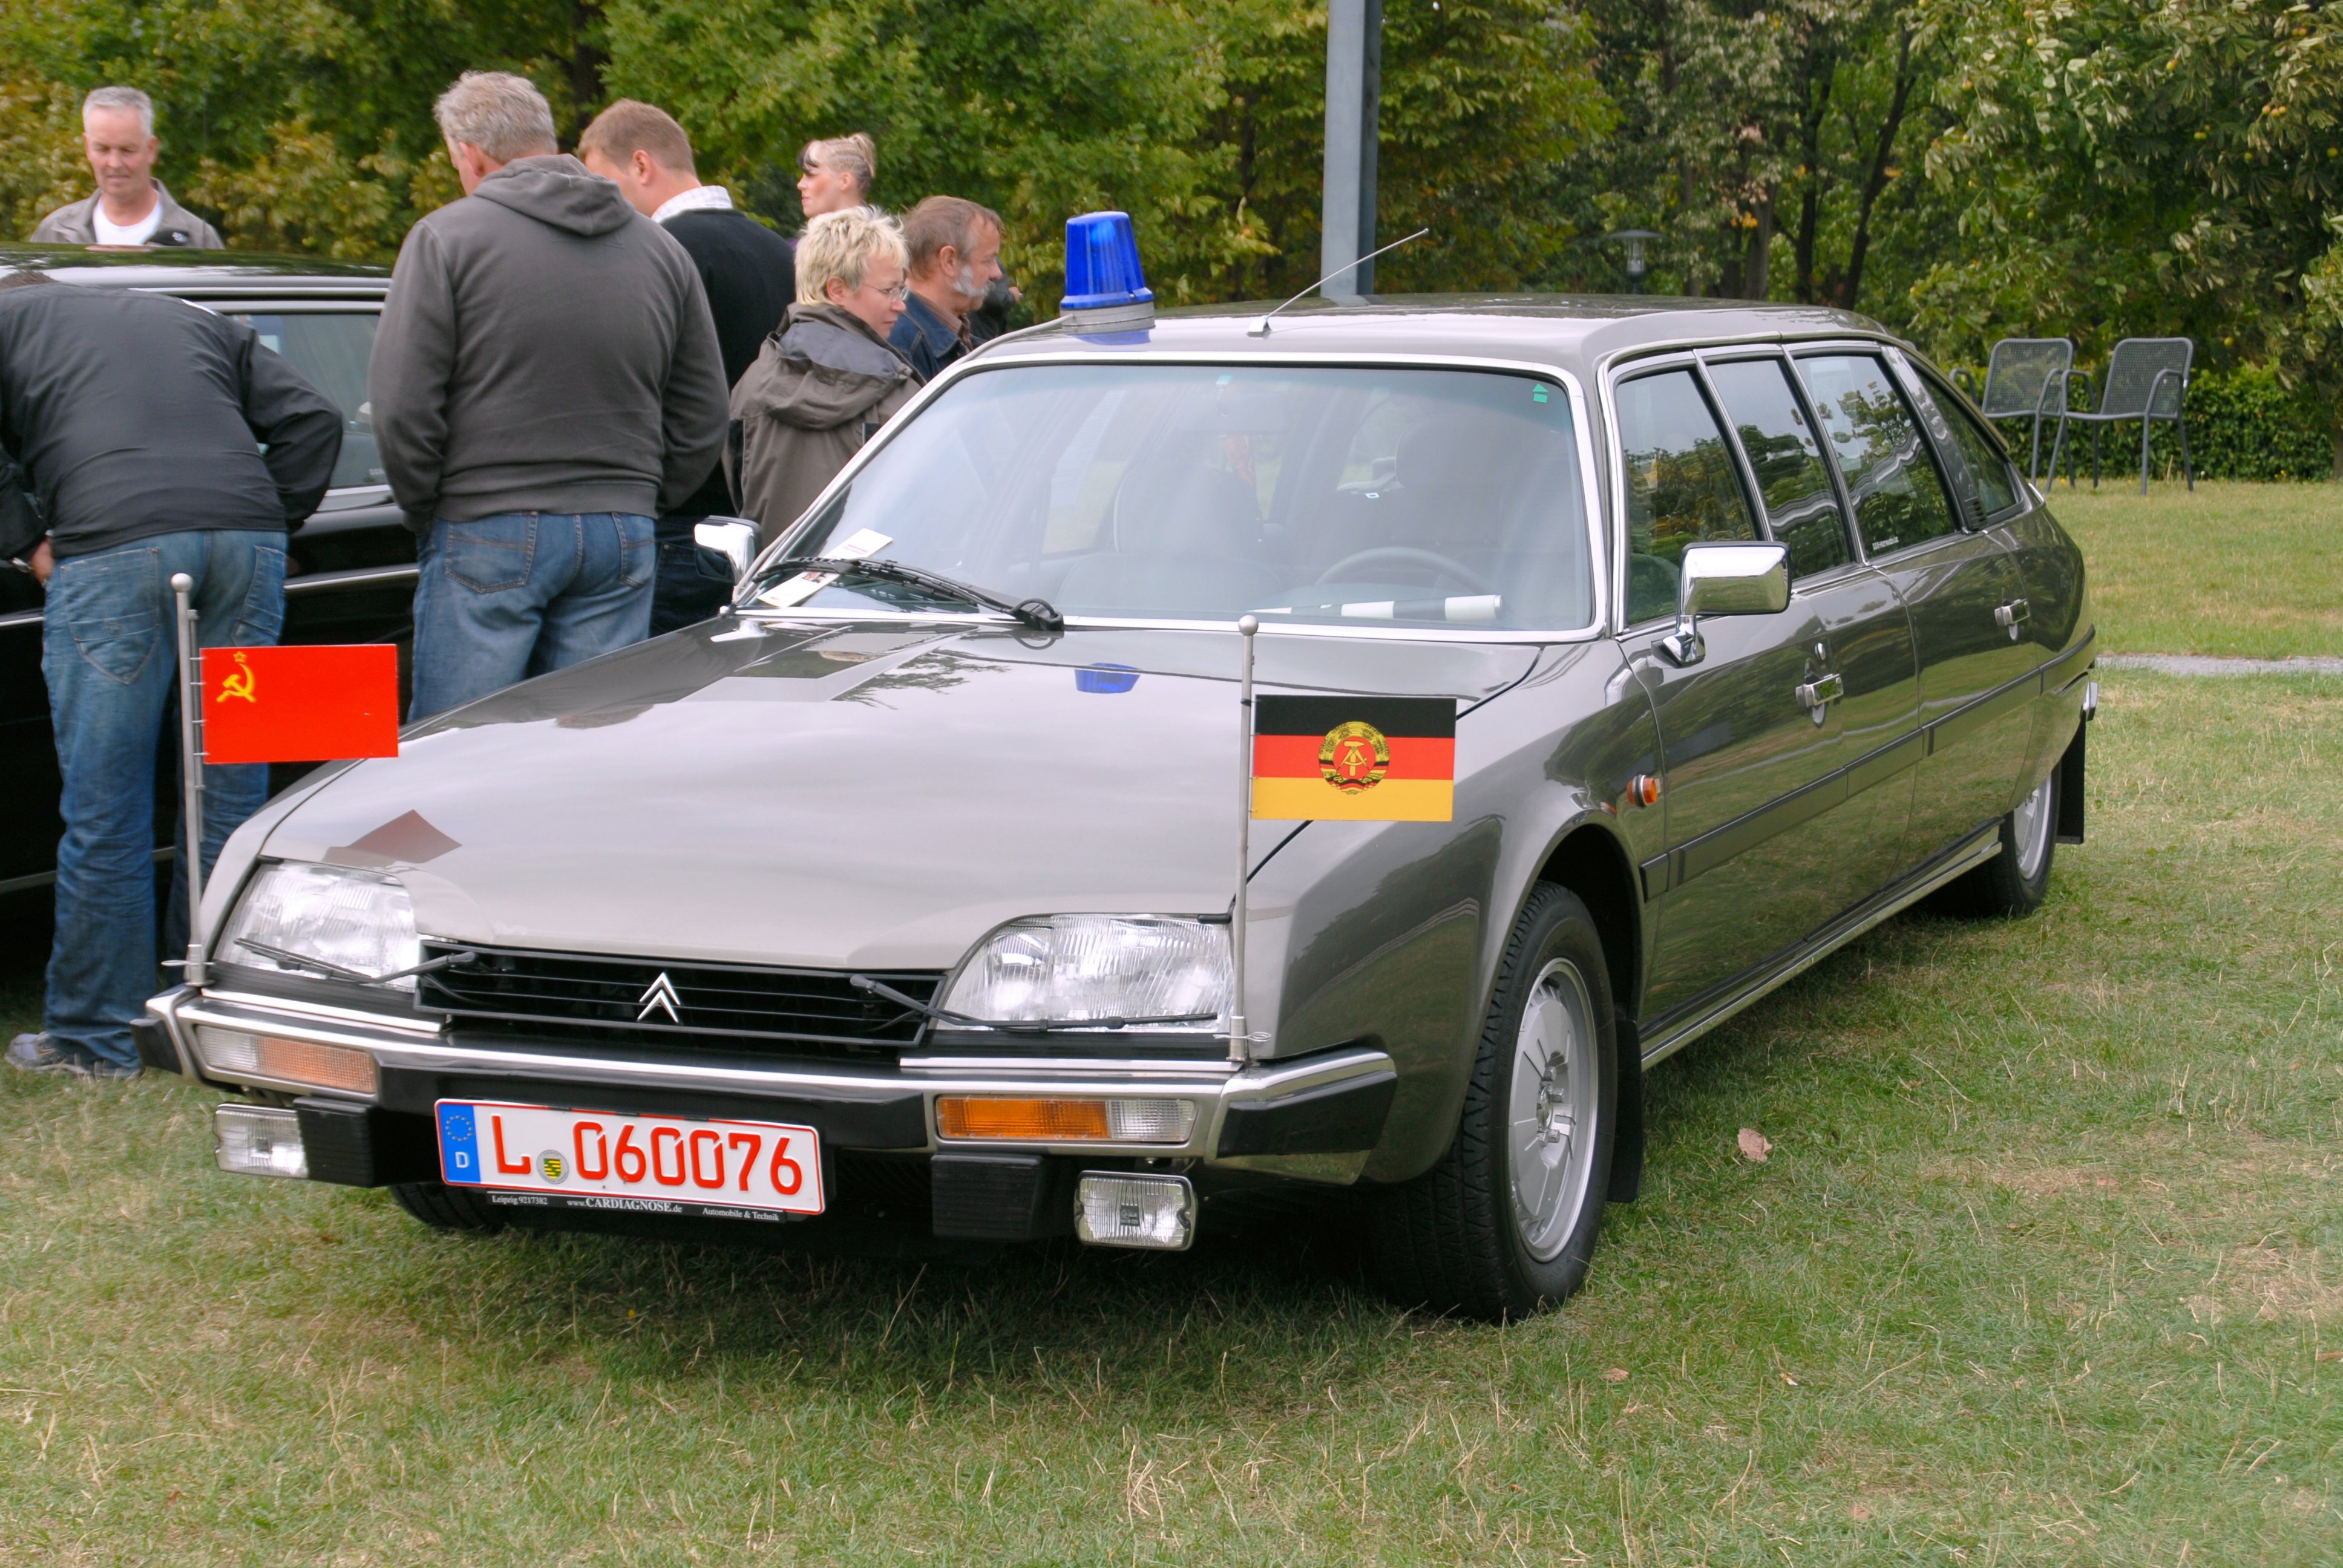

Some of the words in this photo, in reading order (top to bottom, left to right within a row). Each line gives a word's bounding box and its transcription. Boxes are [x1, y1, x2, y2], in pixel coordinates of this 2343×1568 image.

[455, 1151, 468, 1168] D
[491, 1115, 531, 1175] L
[572, 1121, 802, 1196] 060076
[491, 1195, 519, 1205] Leipzig
[566, 1197, 683, 1213] www.CARDIAGNOSE.de
[702, 1207, 742, 1218] Automobile
[752, 1211, 779, 1221] Technik
